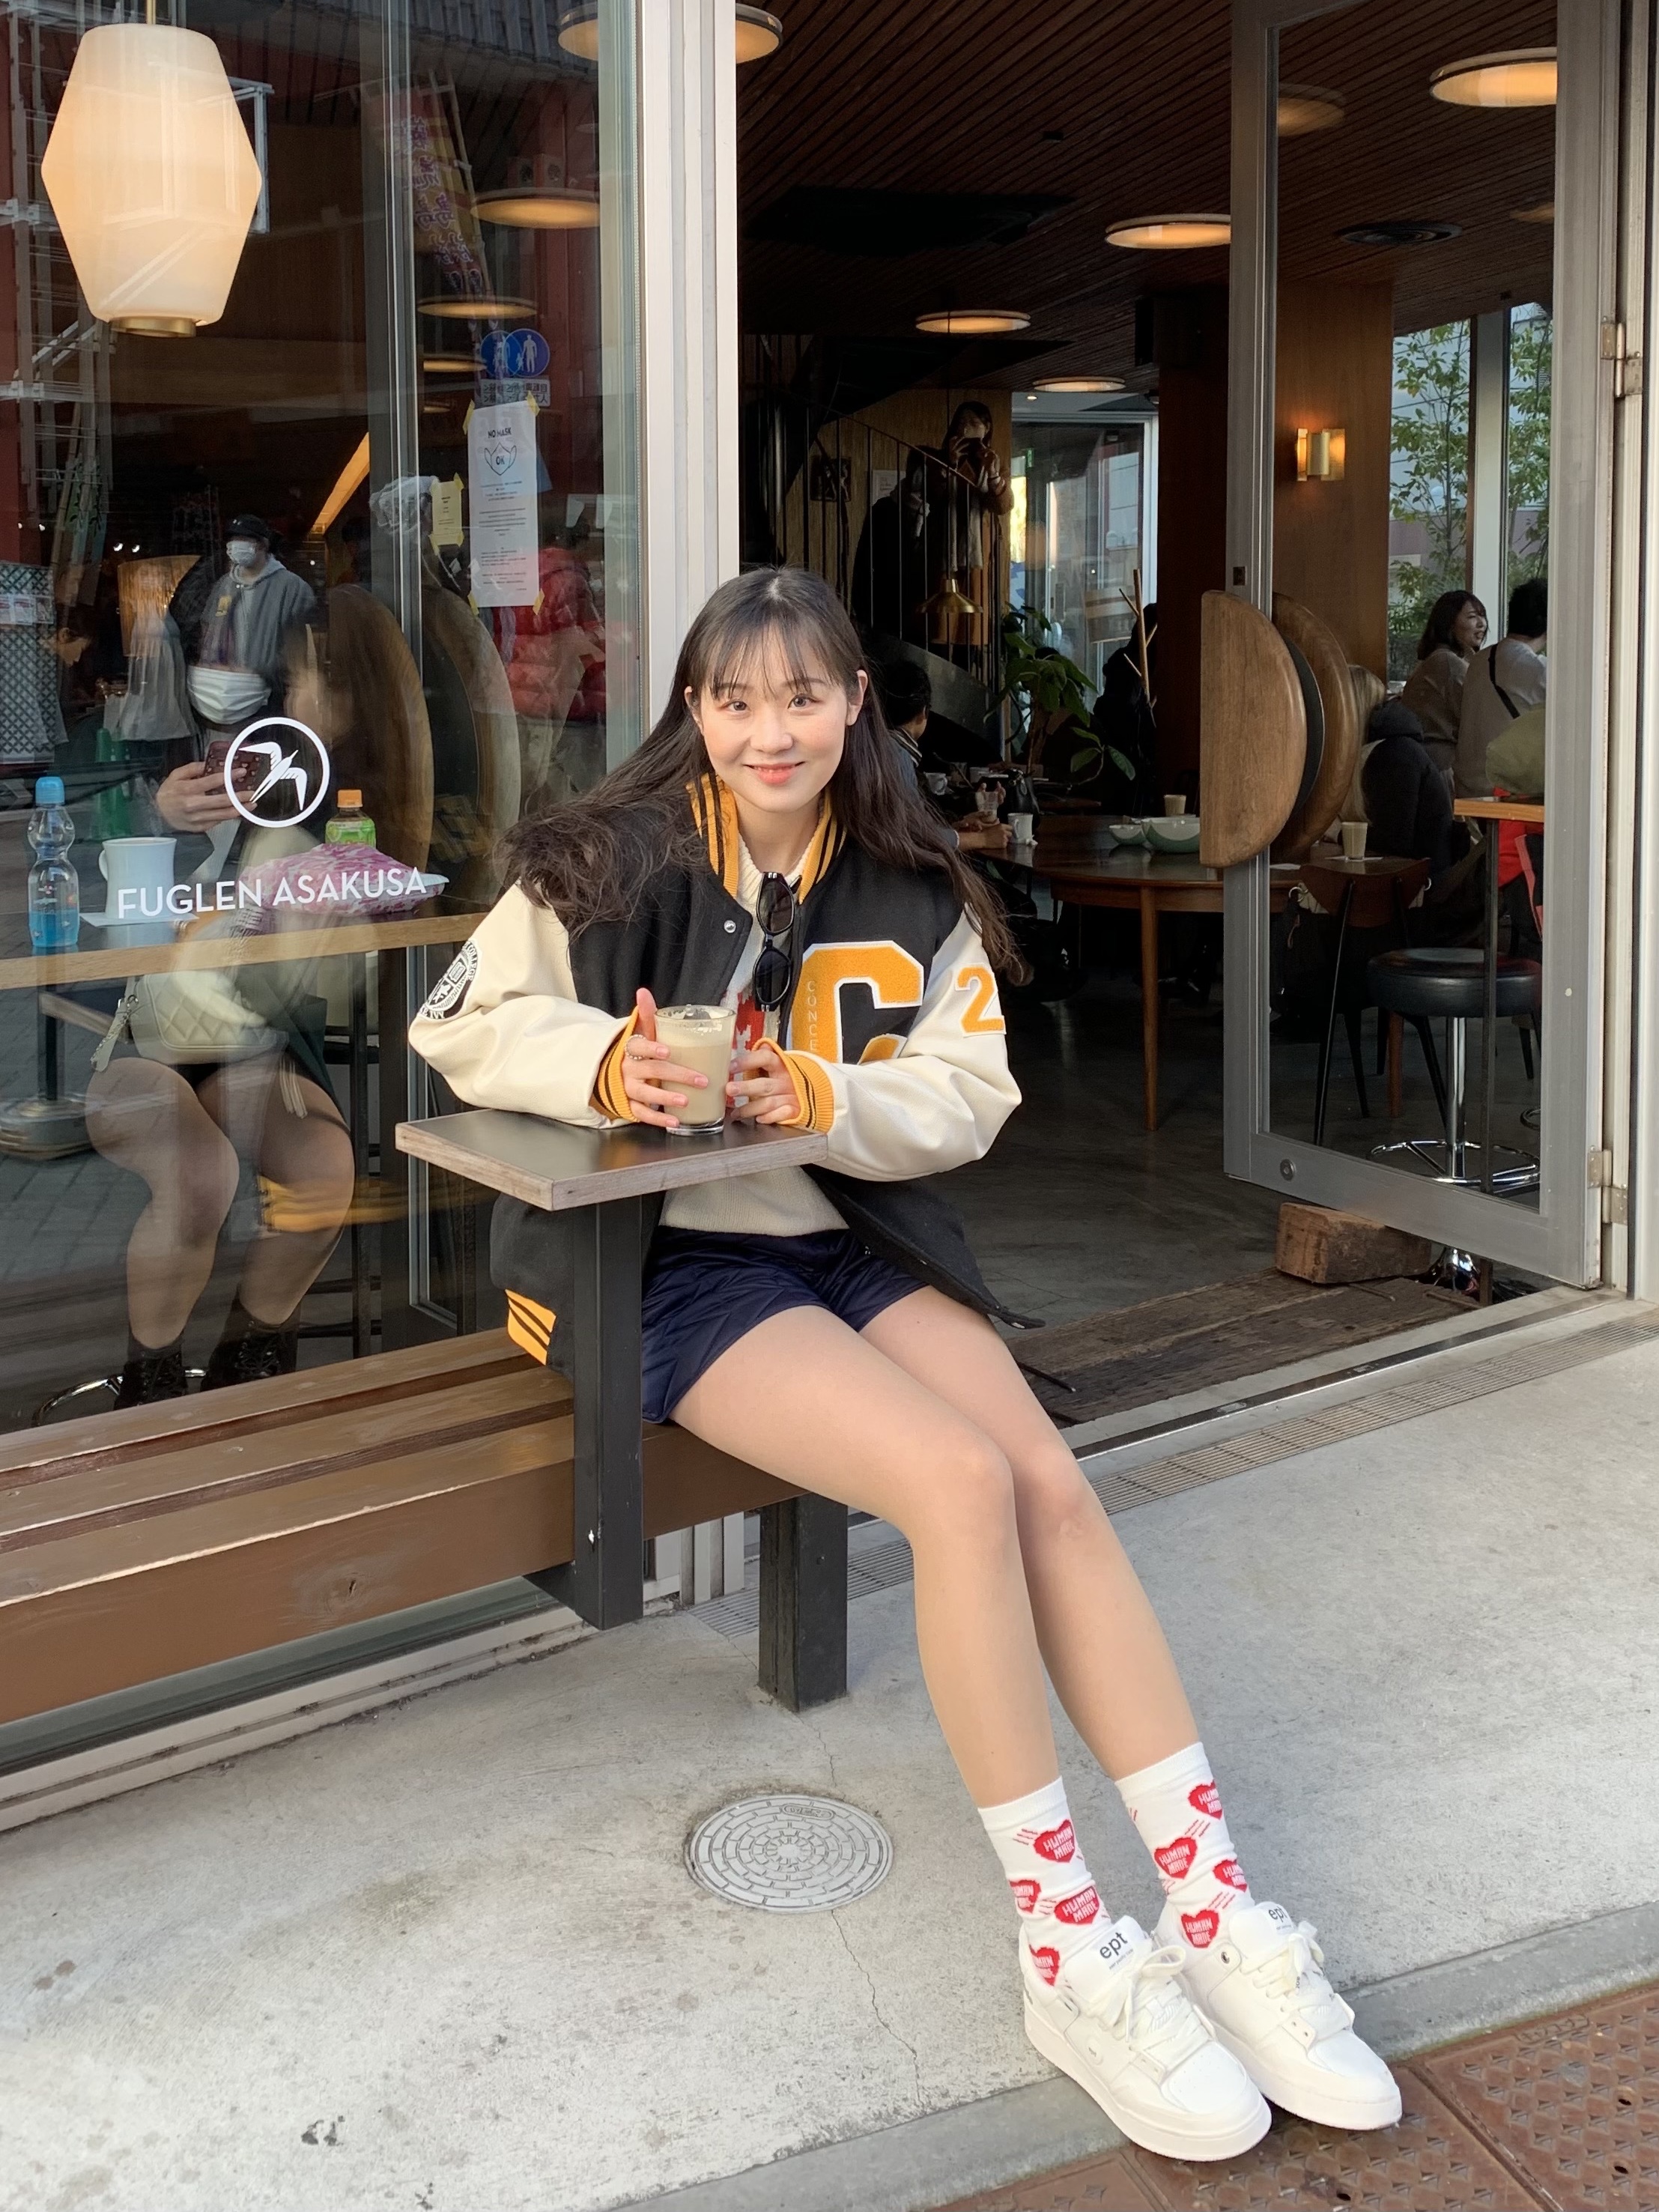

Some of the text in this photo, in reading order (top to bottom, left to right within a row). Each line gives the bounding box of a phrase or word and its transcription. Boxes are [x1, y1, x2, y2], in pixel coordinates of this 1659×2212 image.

[488, 429, 496, 438] NO
[496, 455, 505, 465] OK
[118, 867, 427, 919] FUGLEN ASAKUSA
[787, 940, 924, 1064] C
[954, 963, 1006, 1037] 2
[1159, 1844, 1190, 1866] HUMAN
[1167, 1857, 1189, 1874] MADE
[1061, 1888, 1096, 1917] HUMAN
[1073, 1901, 1098, 1923] MADE
[1185, 1918, 1213, 1933] HUMAN
[1268, 1906, 1288, 1923] ept
[1100, 1932, 1128, 1959] ept
